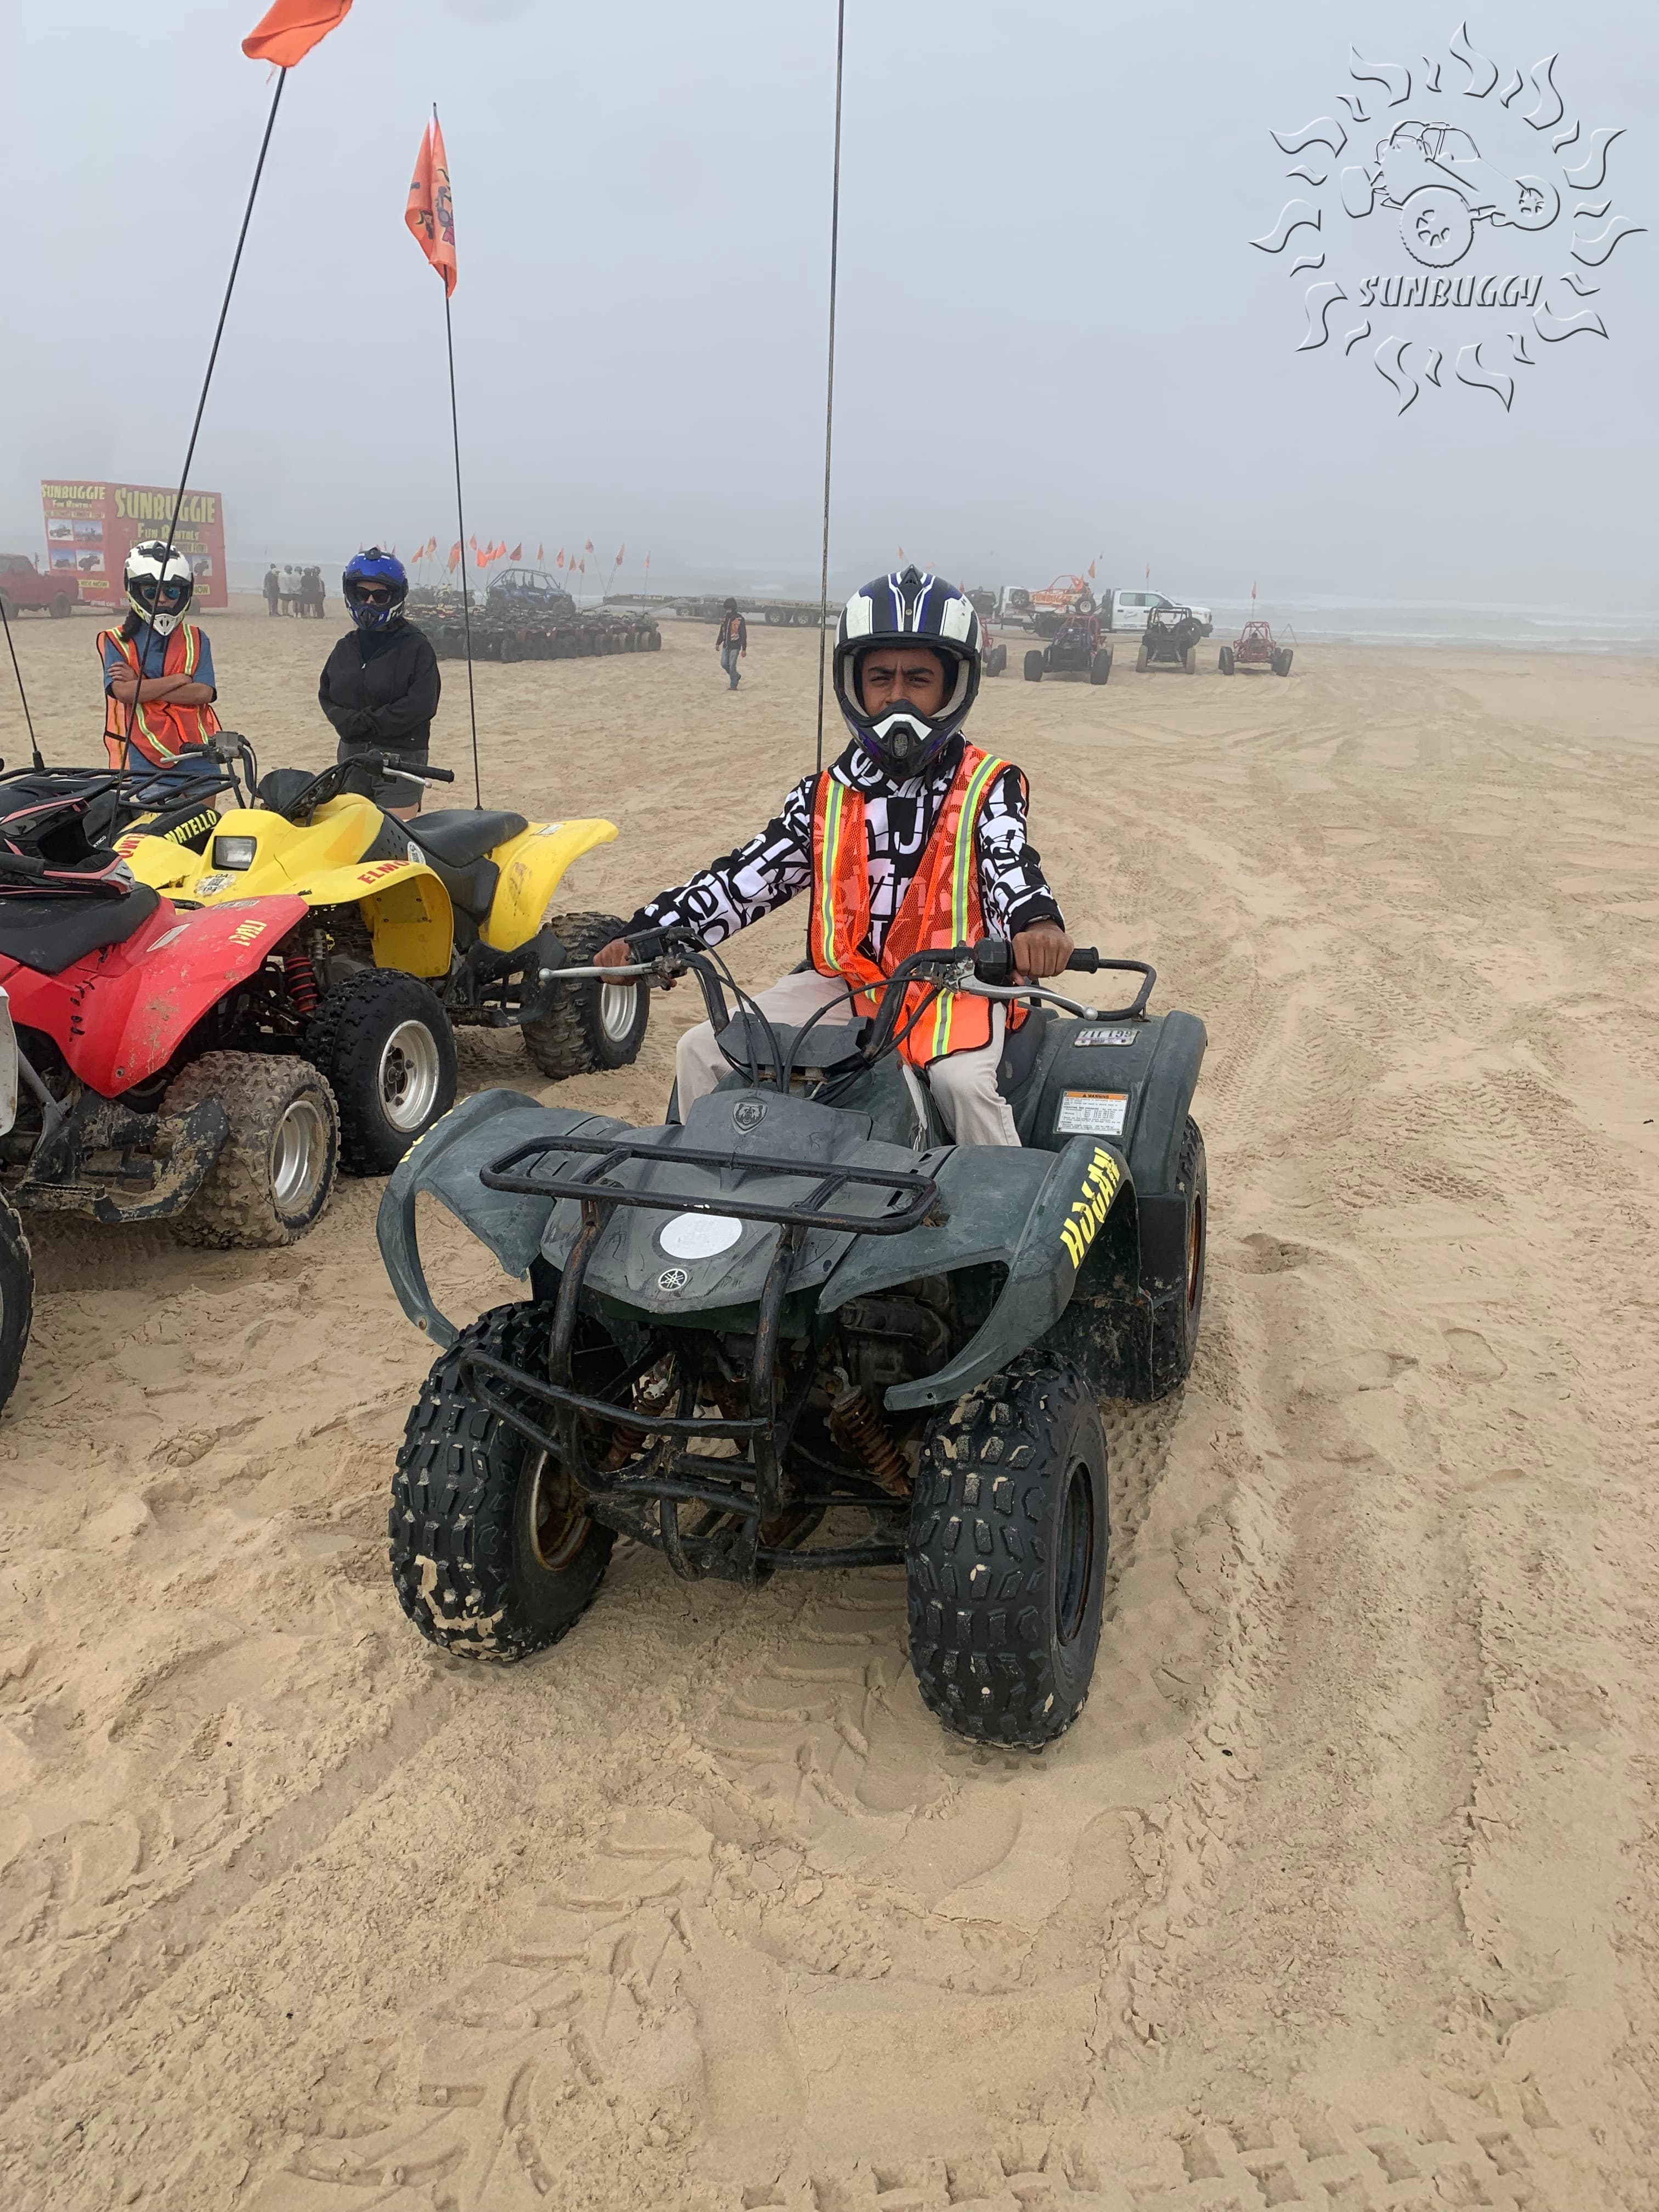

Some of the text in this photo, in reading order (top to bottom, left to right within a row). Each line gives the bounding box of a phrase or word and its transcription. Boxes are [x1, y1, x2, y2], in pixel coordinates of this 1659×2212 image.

[42, 484, 105, 500] SUNBUGGIE
[115, 487, 215, 523] SUNBUGGIE
[161, 524, 200, 540] RNTALS
[357, 860, 410, 884] ELMO
